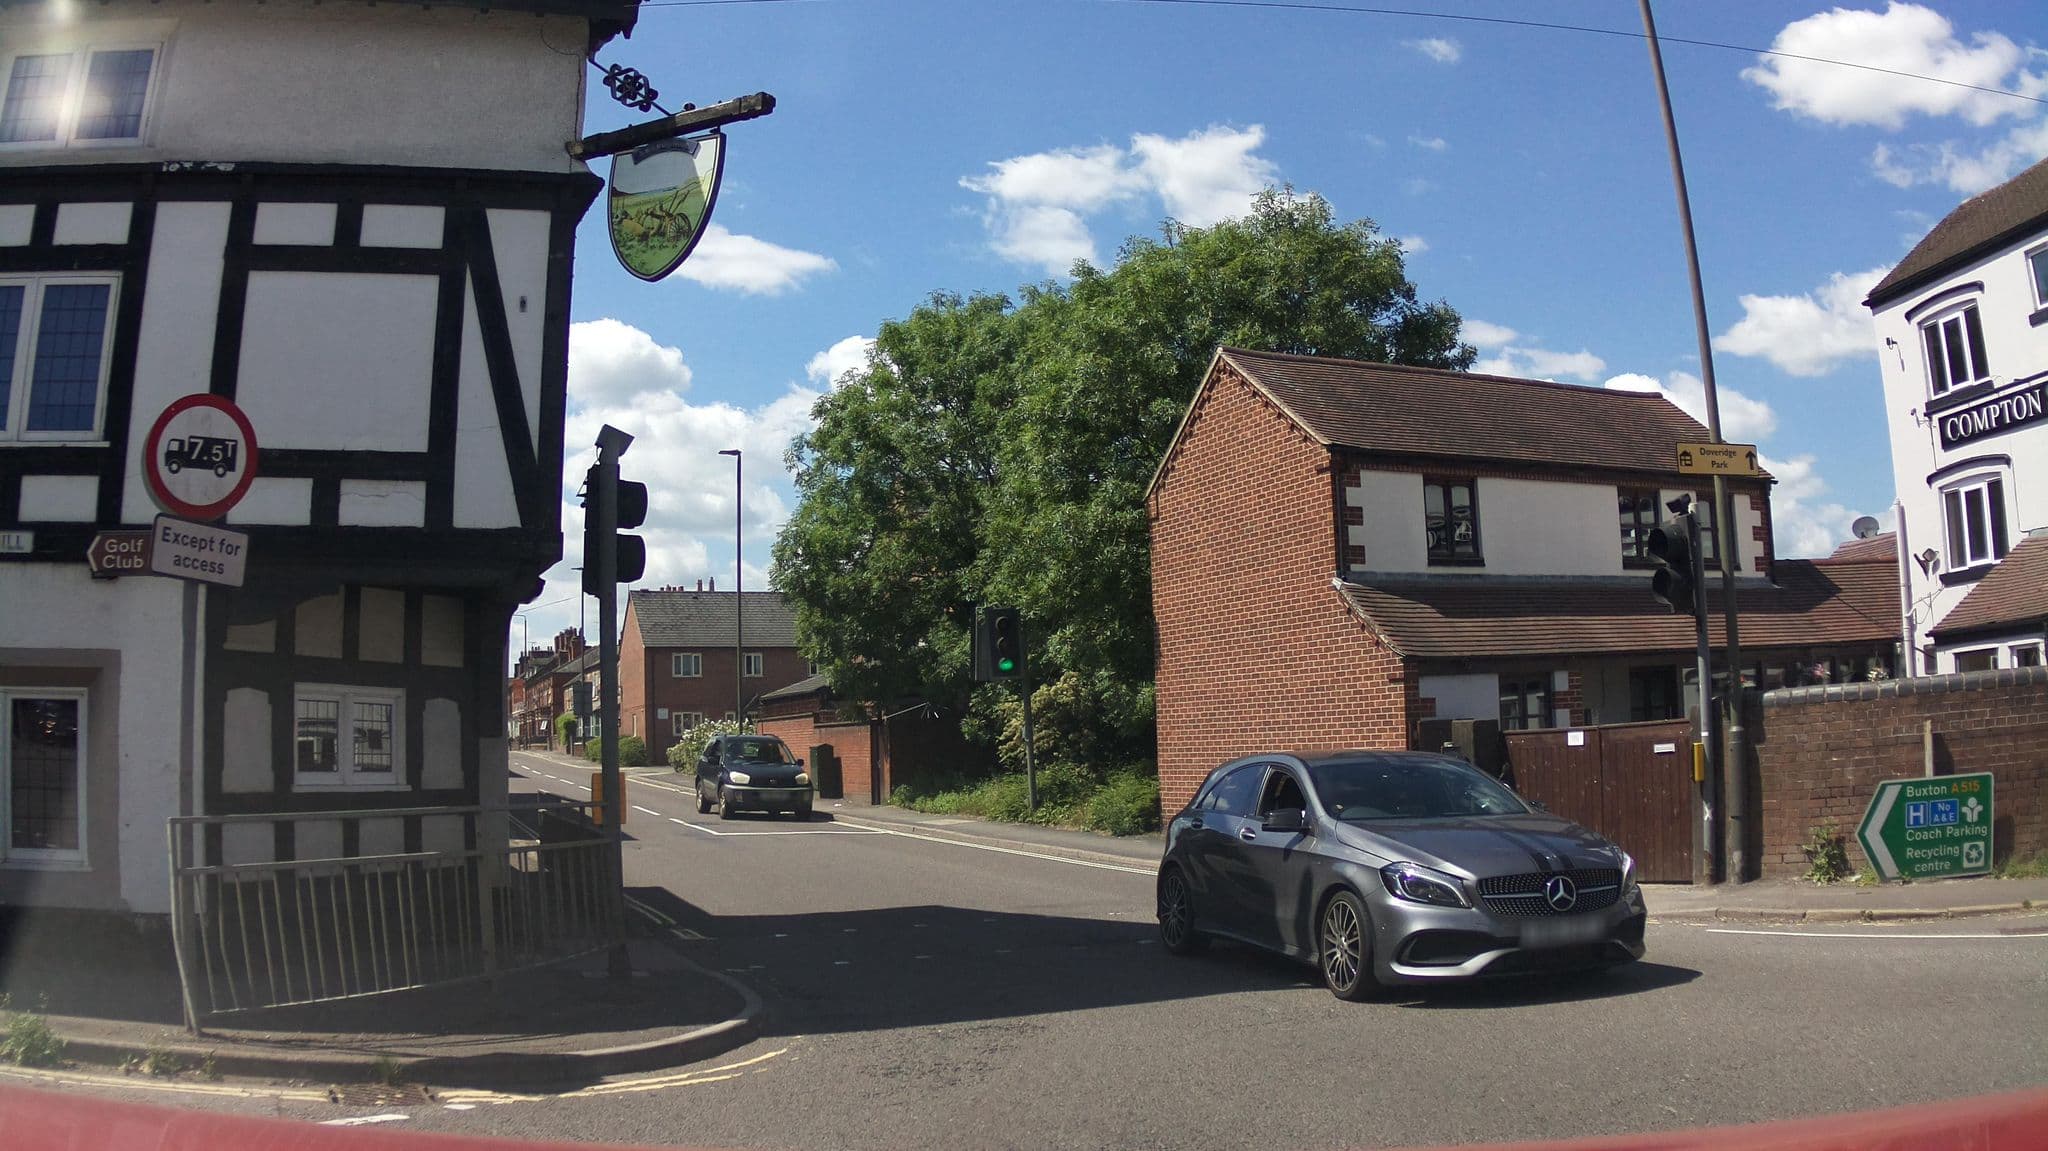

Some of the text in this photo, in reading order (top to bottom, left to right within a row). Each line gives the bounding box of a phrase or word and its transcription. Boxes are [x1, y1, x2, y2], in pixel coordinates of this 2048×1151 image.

[1946, 389, 2042, 441] COMPTON
[189, 438, 237, 462] 7.5T
[1699, 447, 1737, 459] Doveridge
[1711, 460, 1728, 469] Park
[104, 538, 145, 552] Golf
[161, 526, 241, 556] Except for
[102, 554, 145, 569] Club
[172, 553, 225, 575] access
[1906, 785, 1947, 798] Buxton
[1937, 803, 1951, 812] No
[1906, 825, 1988, 841] Coach Parking
[1906, 845, 1960, 860] Recycling
[1914, 861, 1951, 873] centre
